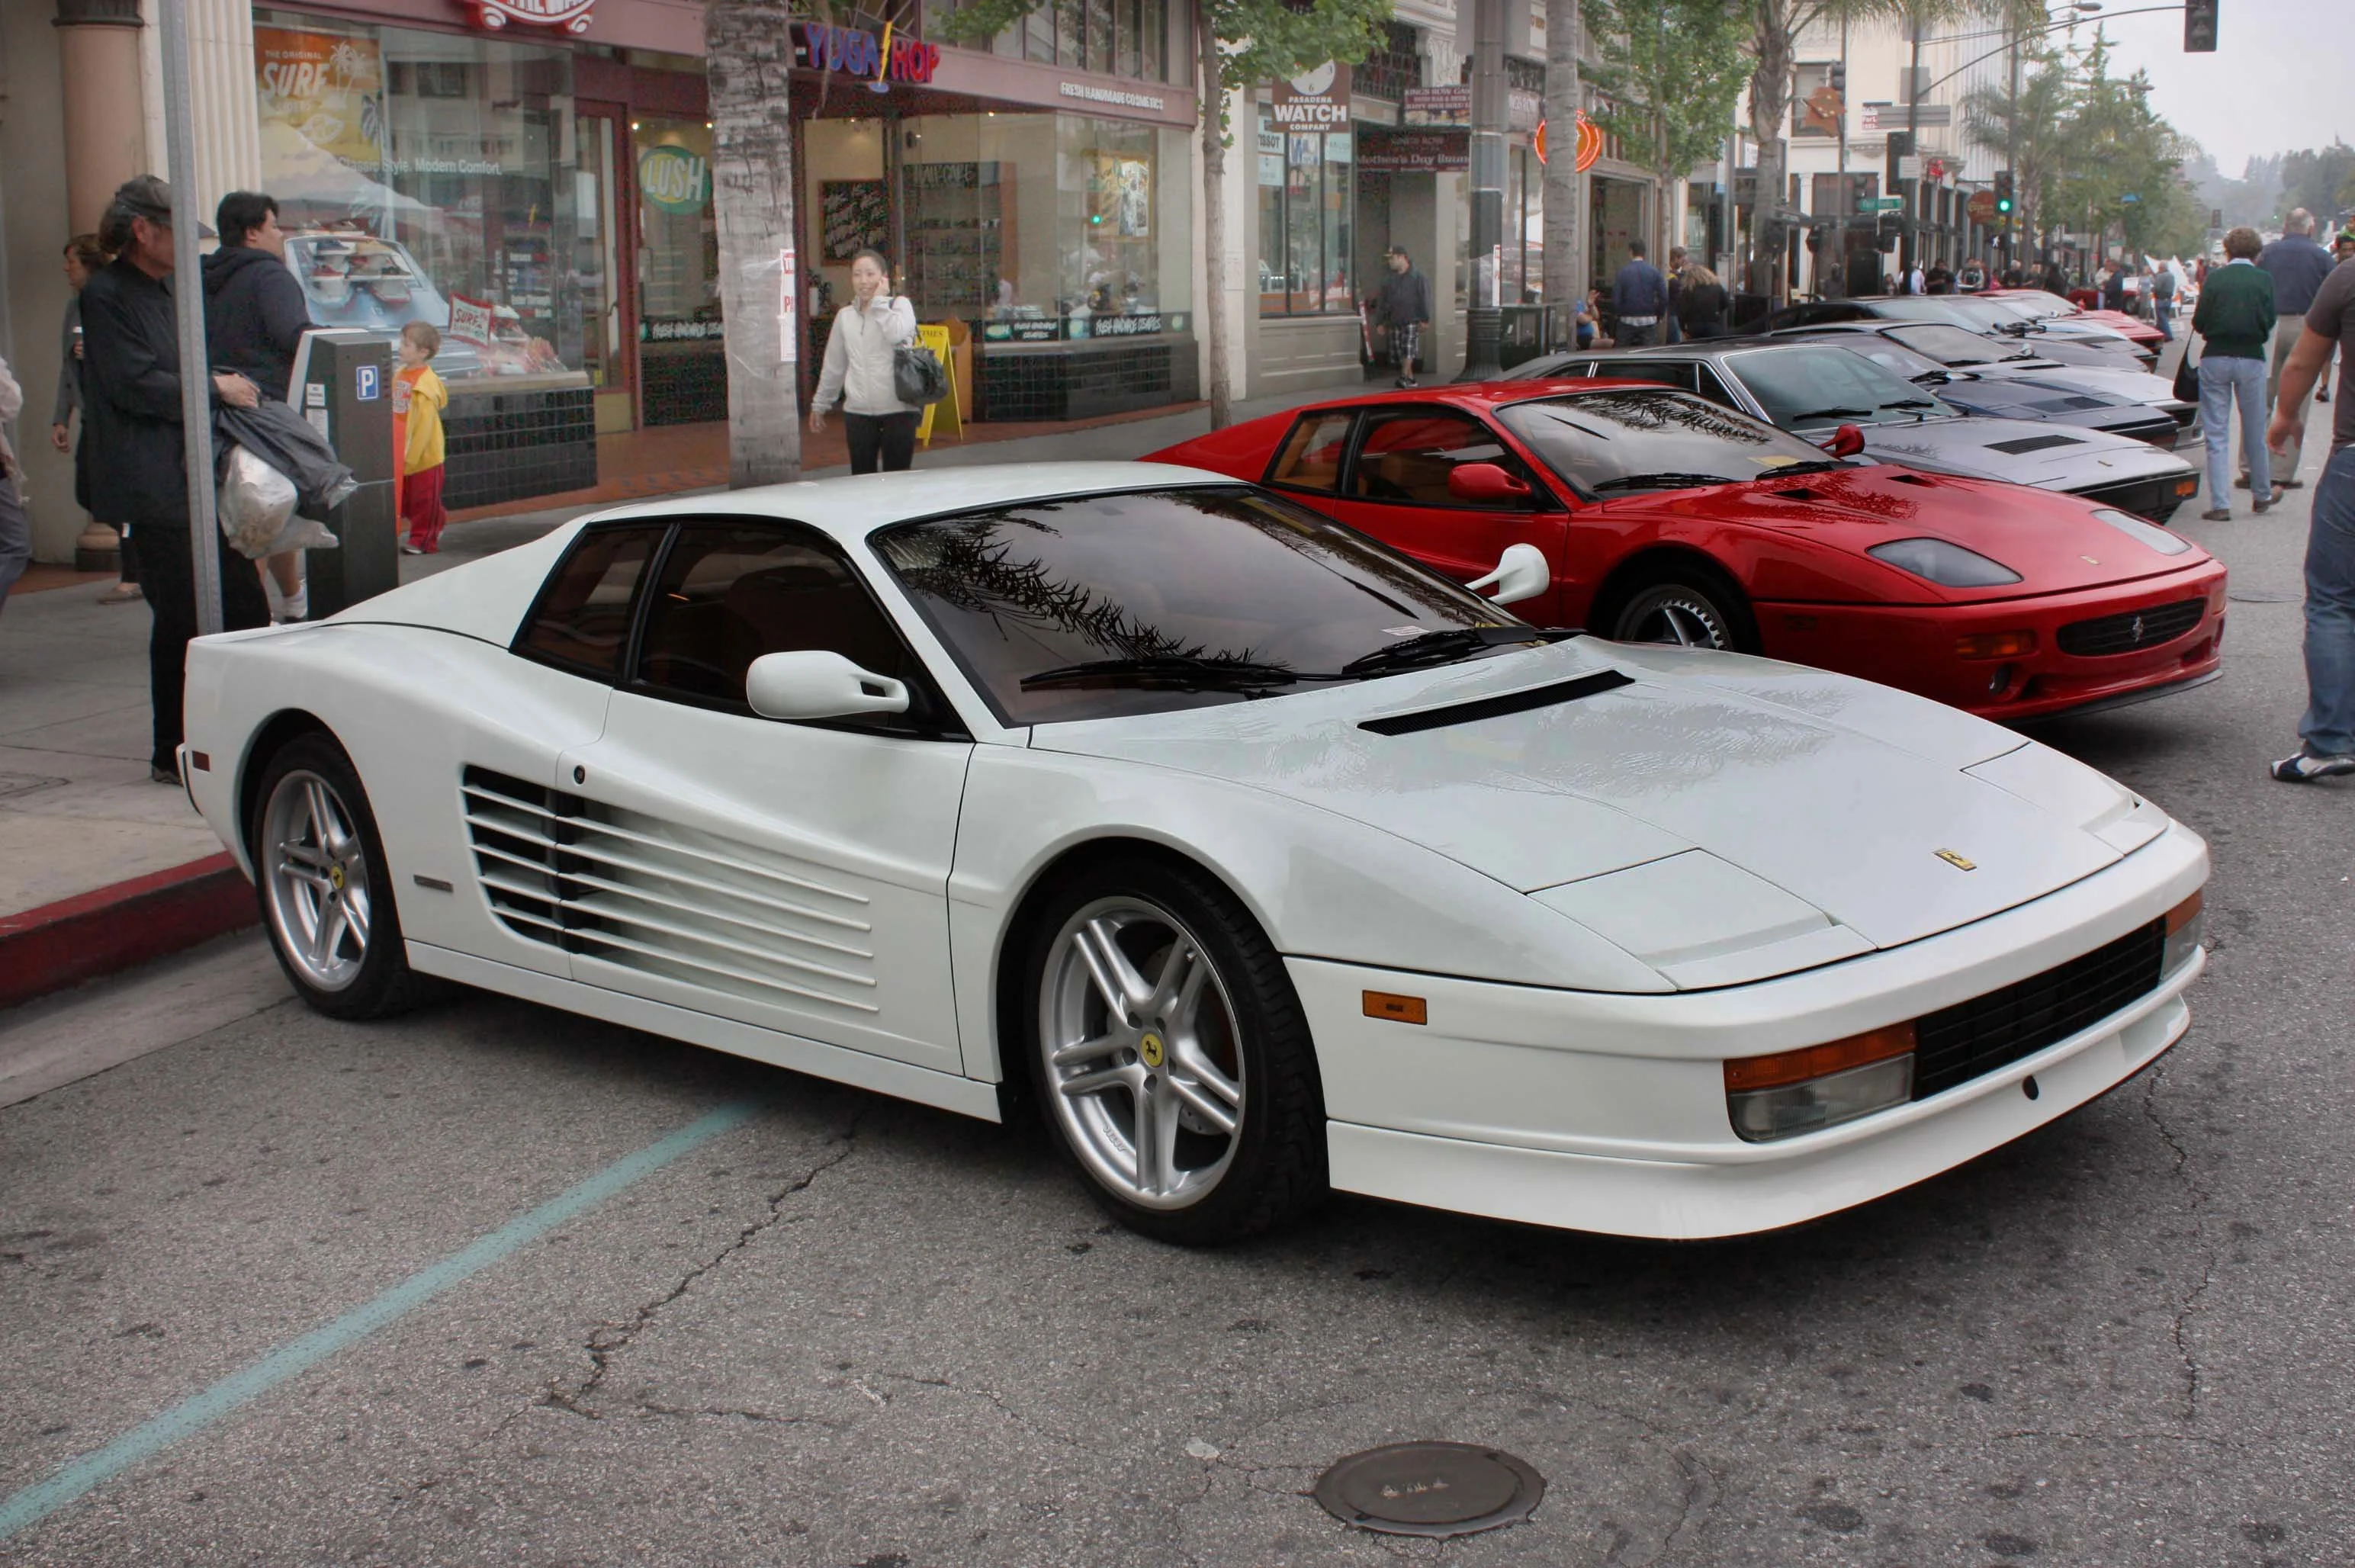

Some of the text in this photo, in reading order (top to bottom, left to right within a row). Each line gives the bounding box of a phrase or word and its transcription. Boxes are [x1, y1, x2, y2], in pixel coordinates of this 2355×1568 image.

[265, 50, 323, 59] THE ORIGINAL
[803, 22, 940, 84] YOGA HOP
[262, 61, 330, 101] SURF
[1061, 82, 1163, 110] FRESH HANDMADE COSMETICS
[1274, 104, 1347, 122] WATCH
[339, 157, 502, 175] Classic Style. Modern Comfort.
[1411, 153, 1434, 165] Day
[1438, 153, 1470, 164] Brun
[645, 156, 705, 201] LUSH
[361, 369, 374, 397] P
